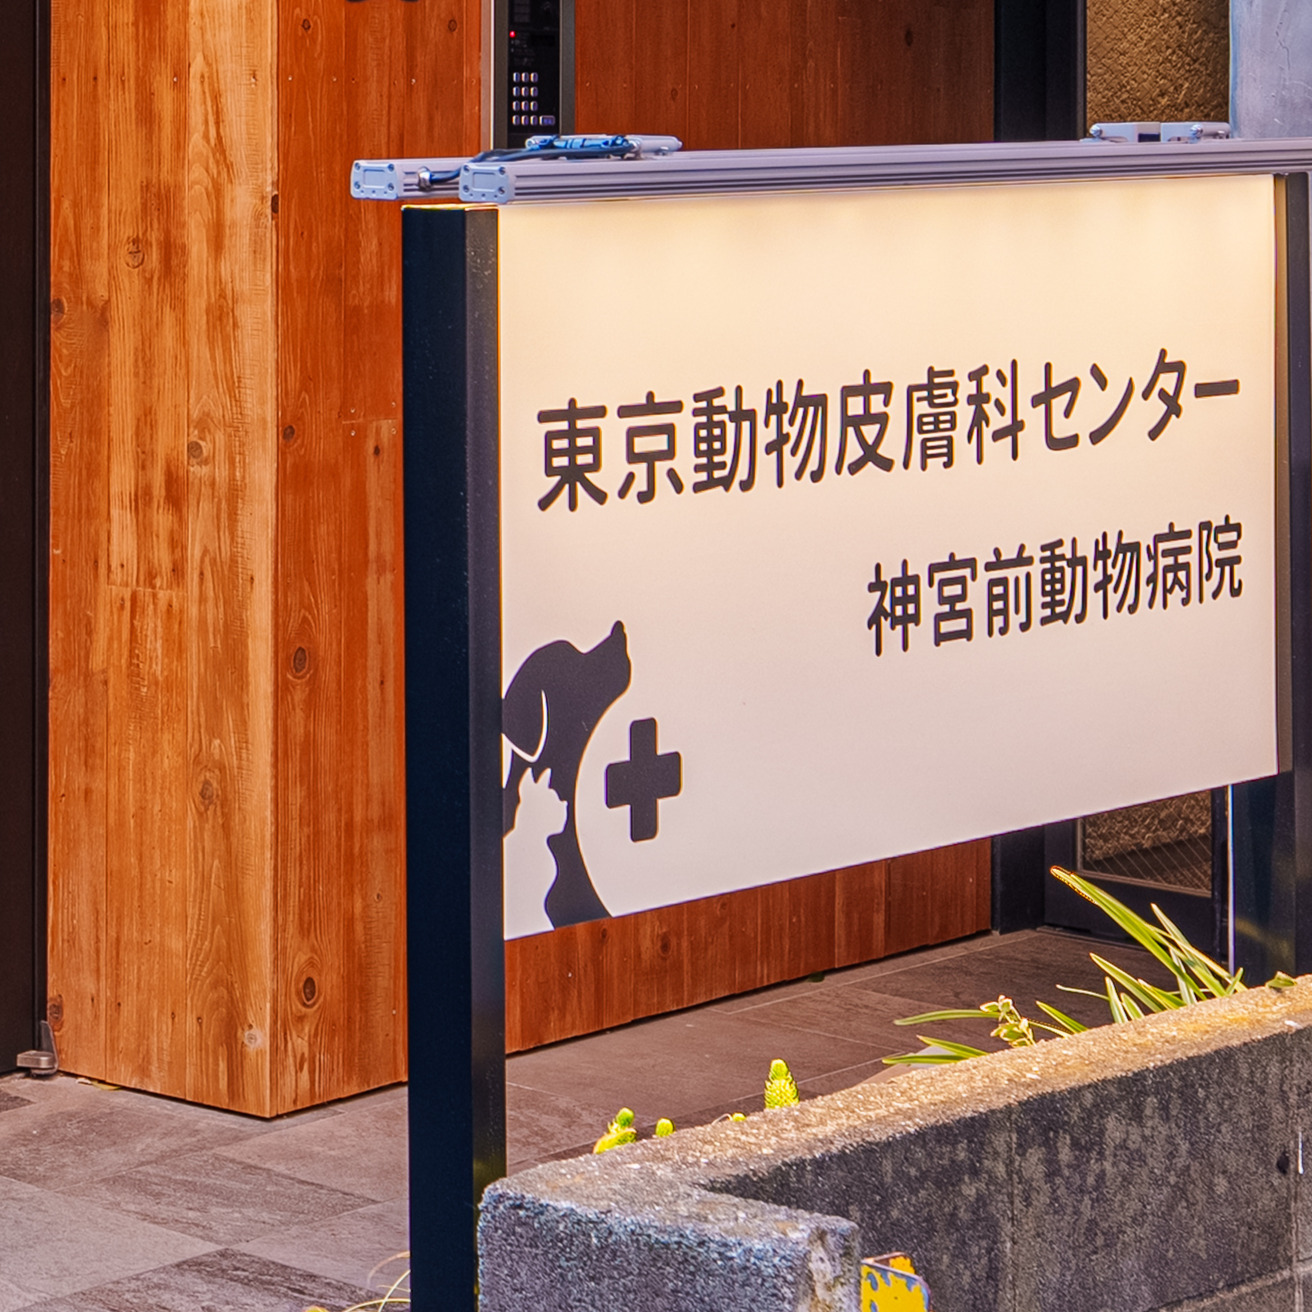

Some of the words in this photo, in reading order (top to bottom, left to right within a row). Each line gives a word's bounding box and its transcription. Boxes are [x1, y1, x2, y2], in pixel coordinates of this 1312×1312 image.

[536, 346, 1242, 513] 東京動物皮膚科センター
[866, 514, 1245, 659] 神宮前動物病院
